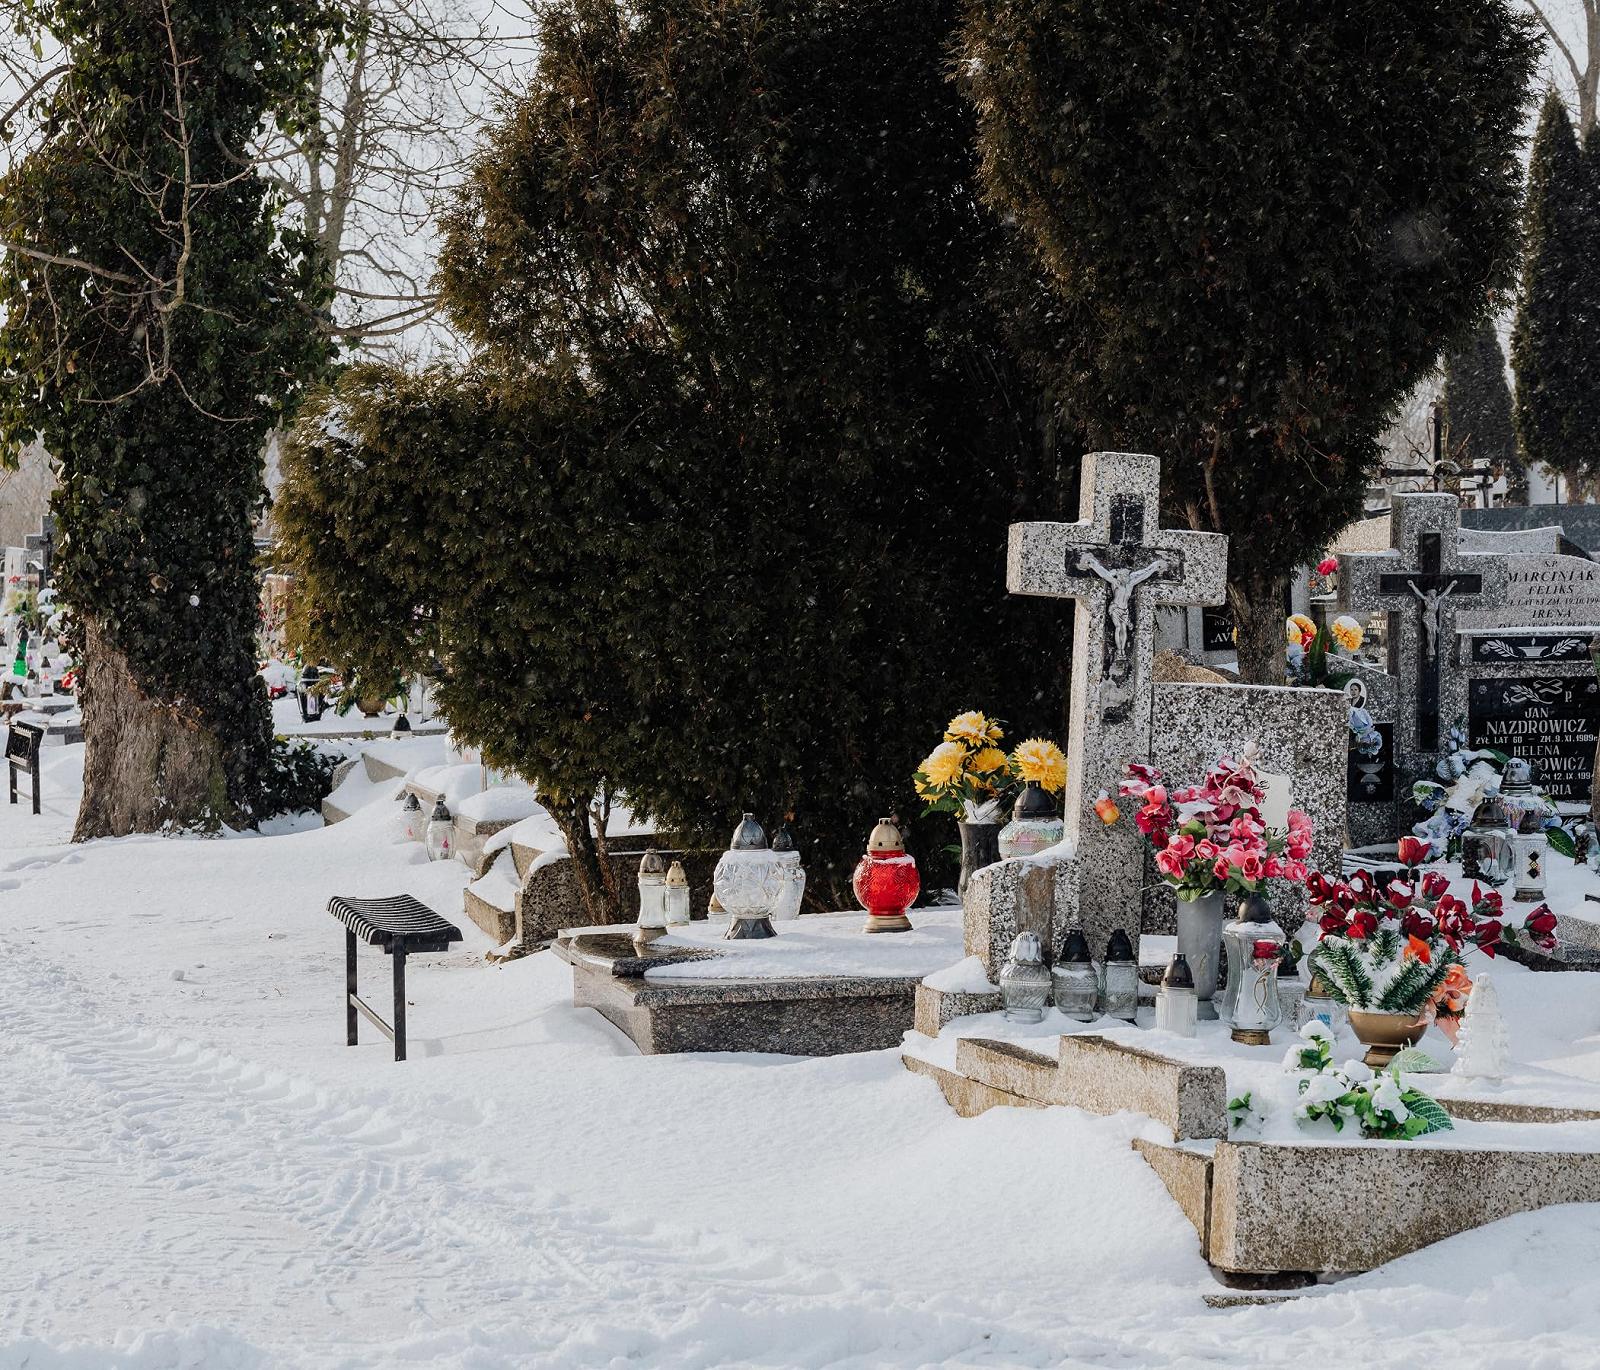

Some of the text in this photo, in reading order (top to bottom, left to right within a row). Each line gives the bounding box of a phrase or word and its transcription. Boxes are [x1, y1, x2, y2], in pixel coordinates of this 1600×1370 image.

[1507, 569, 1595, 582] MARCINIAK
[1528, 585, 1575, 595] FELIKS
[1532, 608, 1572, 618] IRENA
[1524, 707, 1549, 718] JAN
[1486, 719, 1587, 735] NAZDROWICZ
[1494, 736, 1509, 744] LAT
[1513, 745, 1560, 757] HELENA
[1553, 771, 1594, 780] 12.IX.199
[1541, 784, 1572, 795] ARIA
